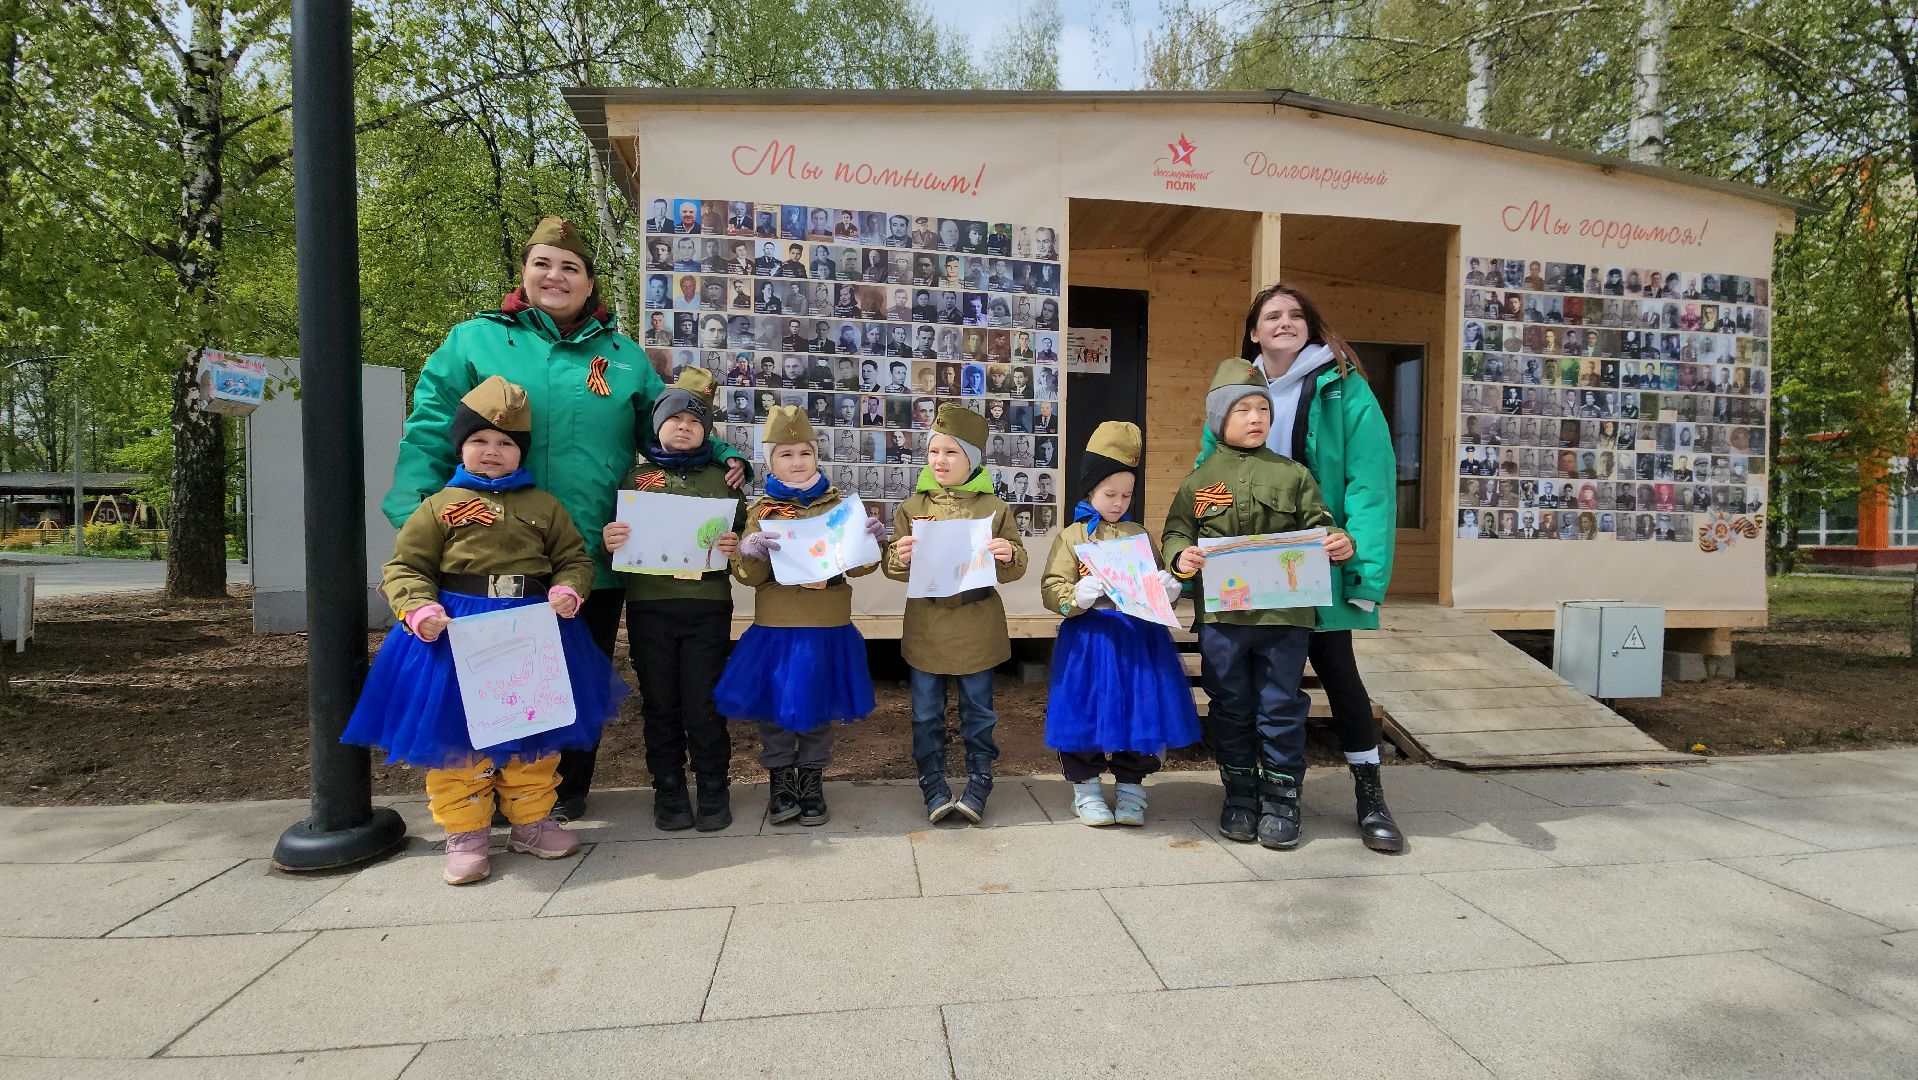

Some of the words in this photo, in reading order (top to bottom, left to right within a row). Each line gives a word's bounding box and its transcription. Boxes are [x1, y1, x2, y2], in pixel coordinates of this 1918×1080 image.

[732, 140, 823, 179] Мы
[835, 162, 985, 196] помним!
[1165, 180, 1197, 192] ПОЛК
[1244, 151, 1388, 190] Долгопрудный
[1502, 200, 1571, 234] Мы
[1580, 218, 1709, 249] гордимся!
